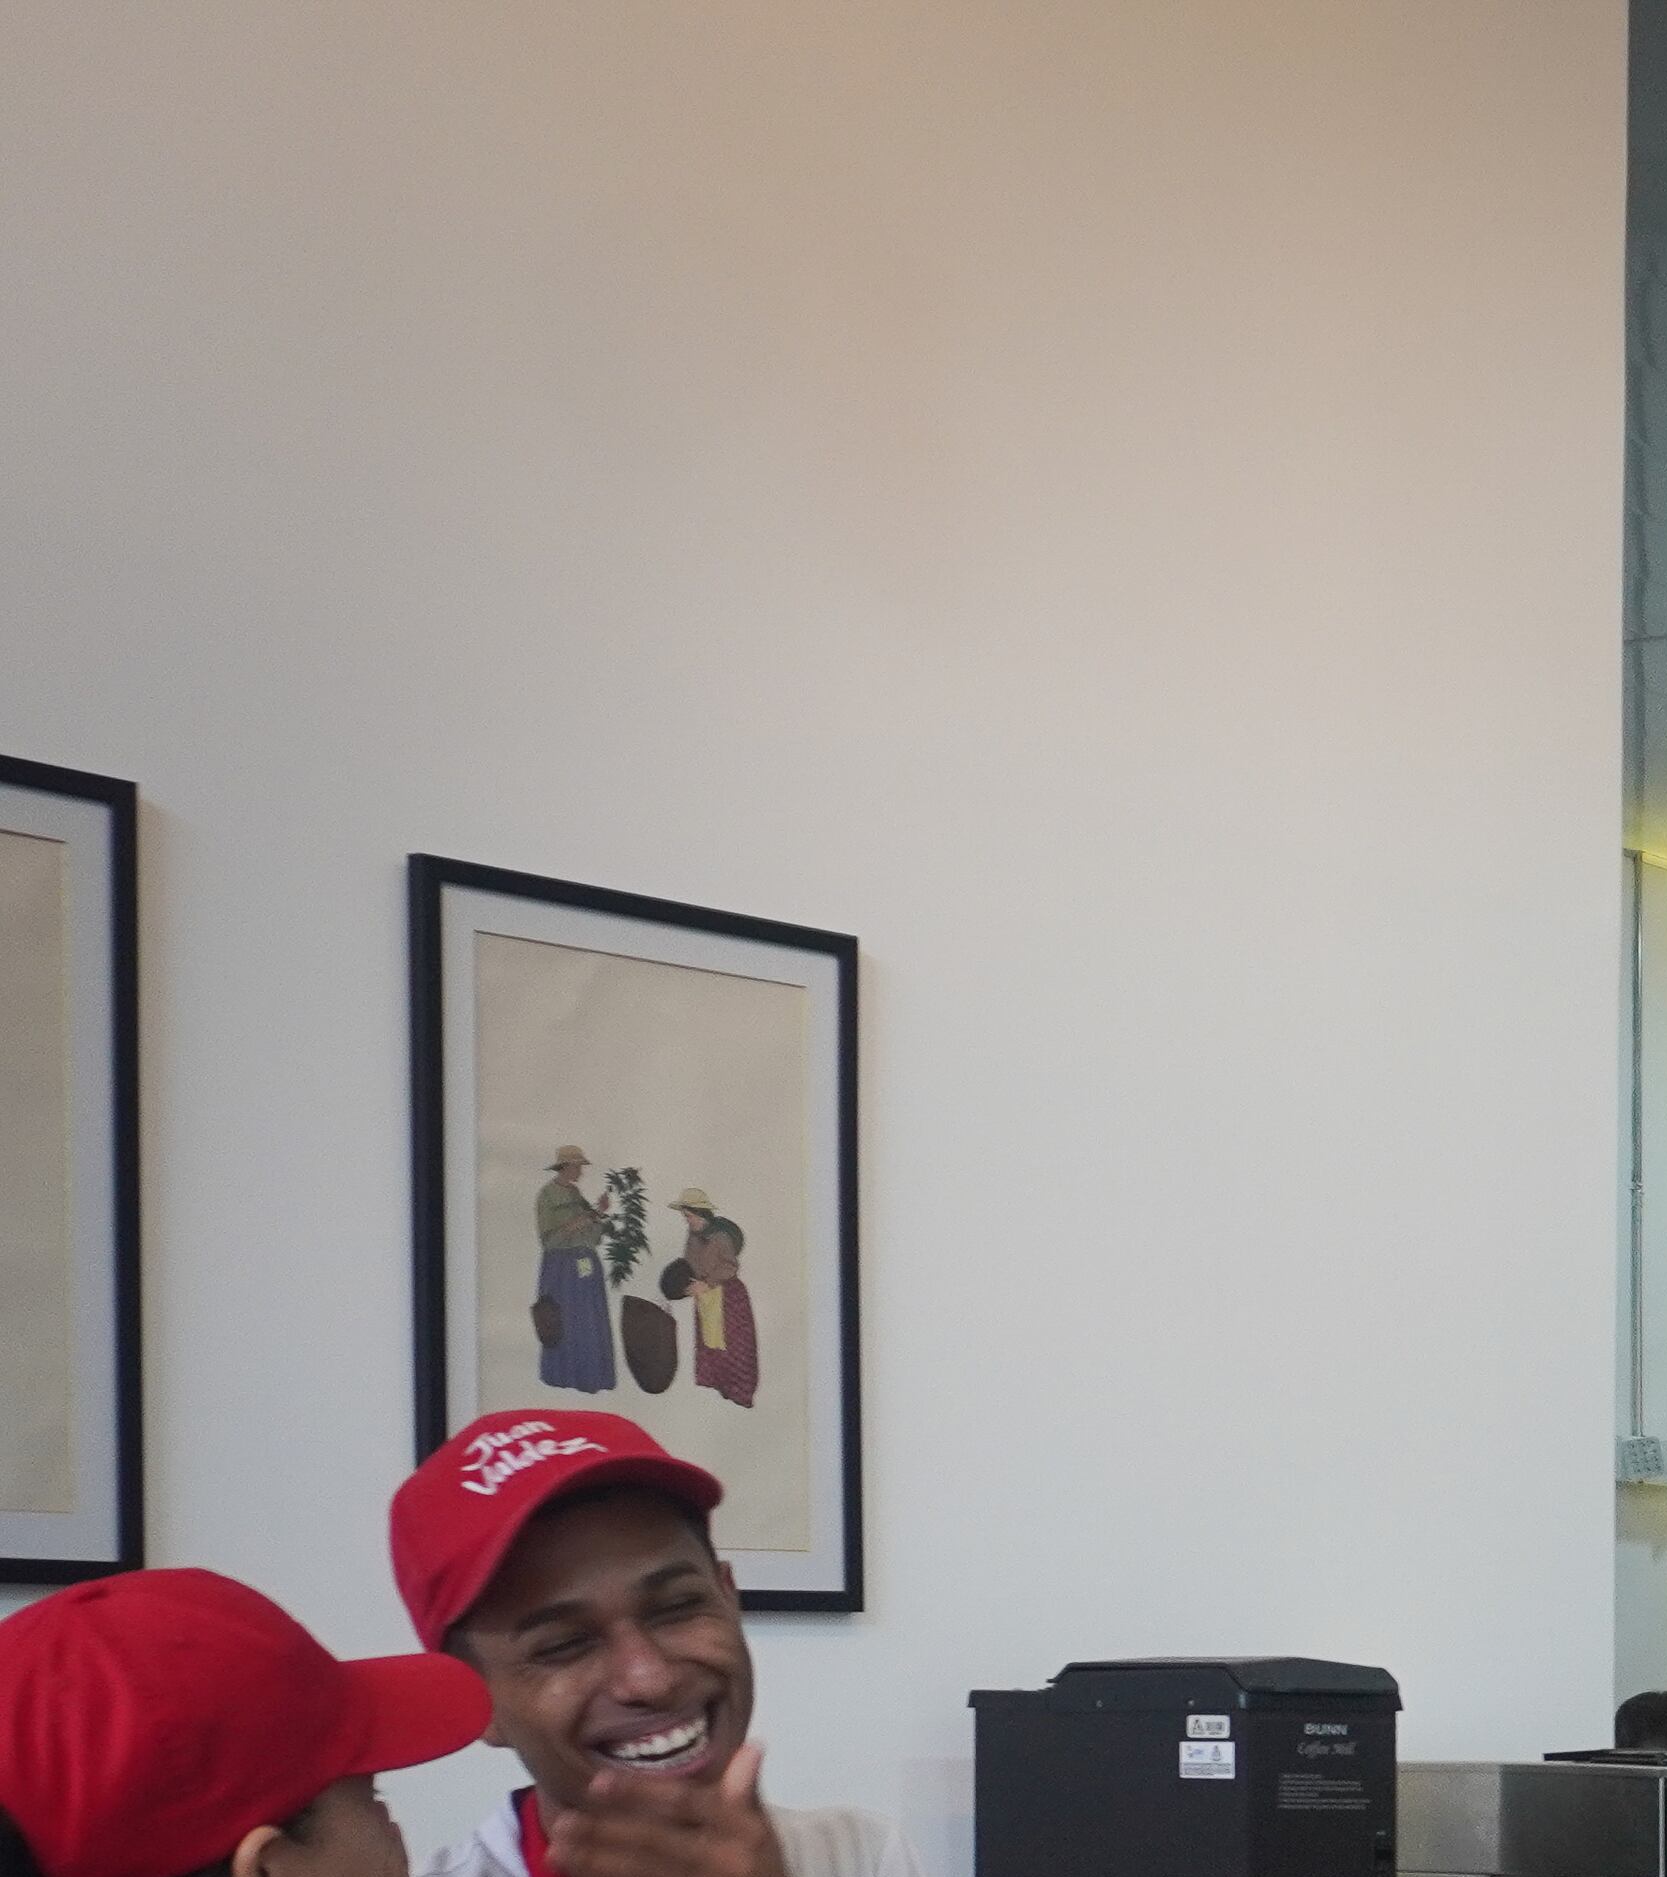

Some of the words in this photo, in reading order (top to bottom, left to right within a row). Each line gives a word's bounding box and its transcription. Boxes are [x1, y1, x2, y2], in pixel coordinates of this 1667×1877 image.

[461, 1421, 556, 1471] Juan
[461, 1437, 609, 1495] Valdez
[1303, 1722, 1348, 1736] BUNN
